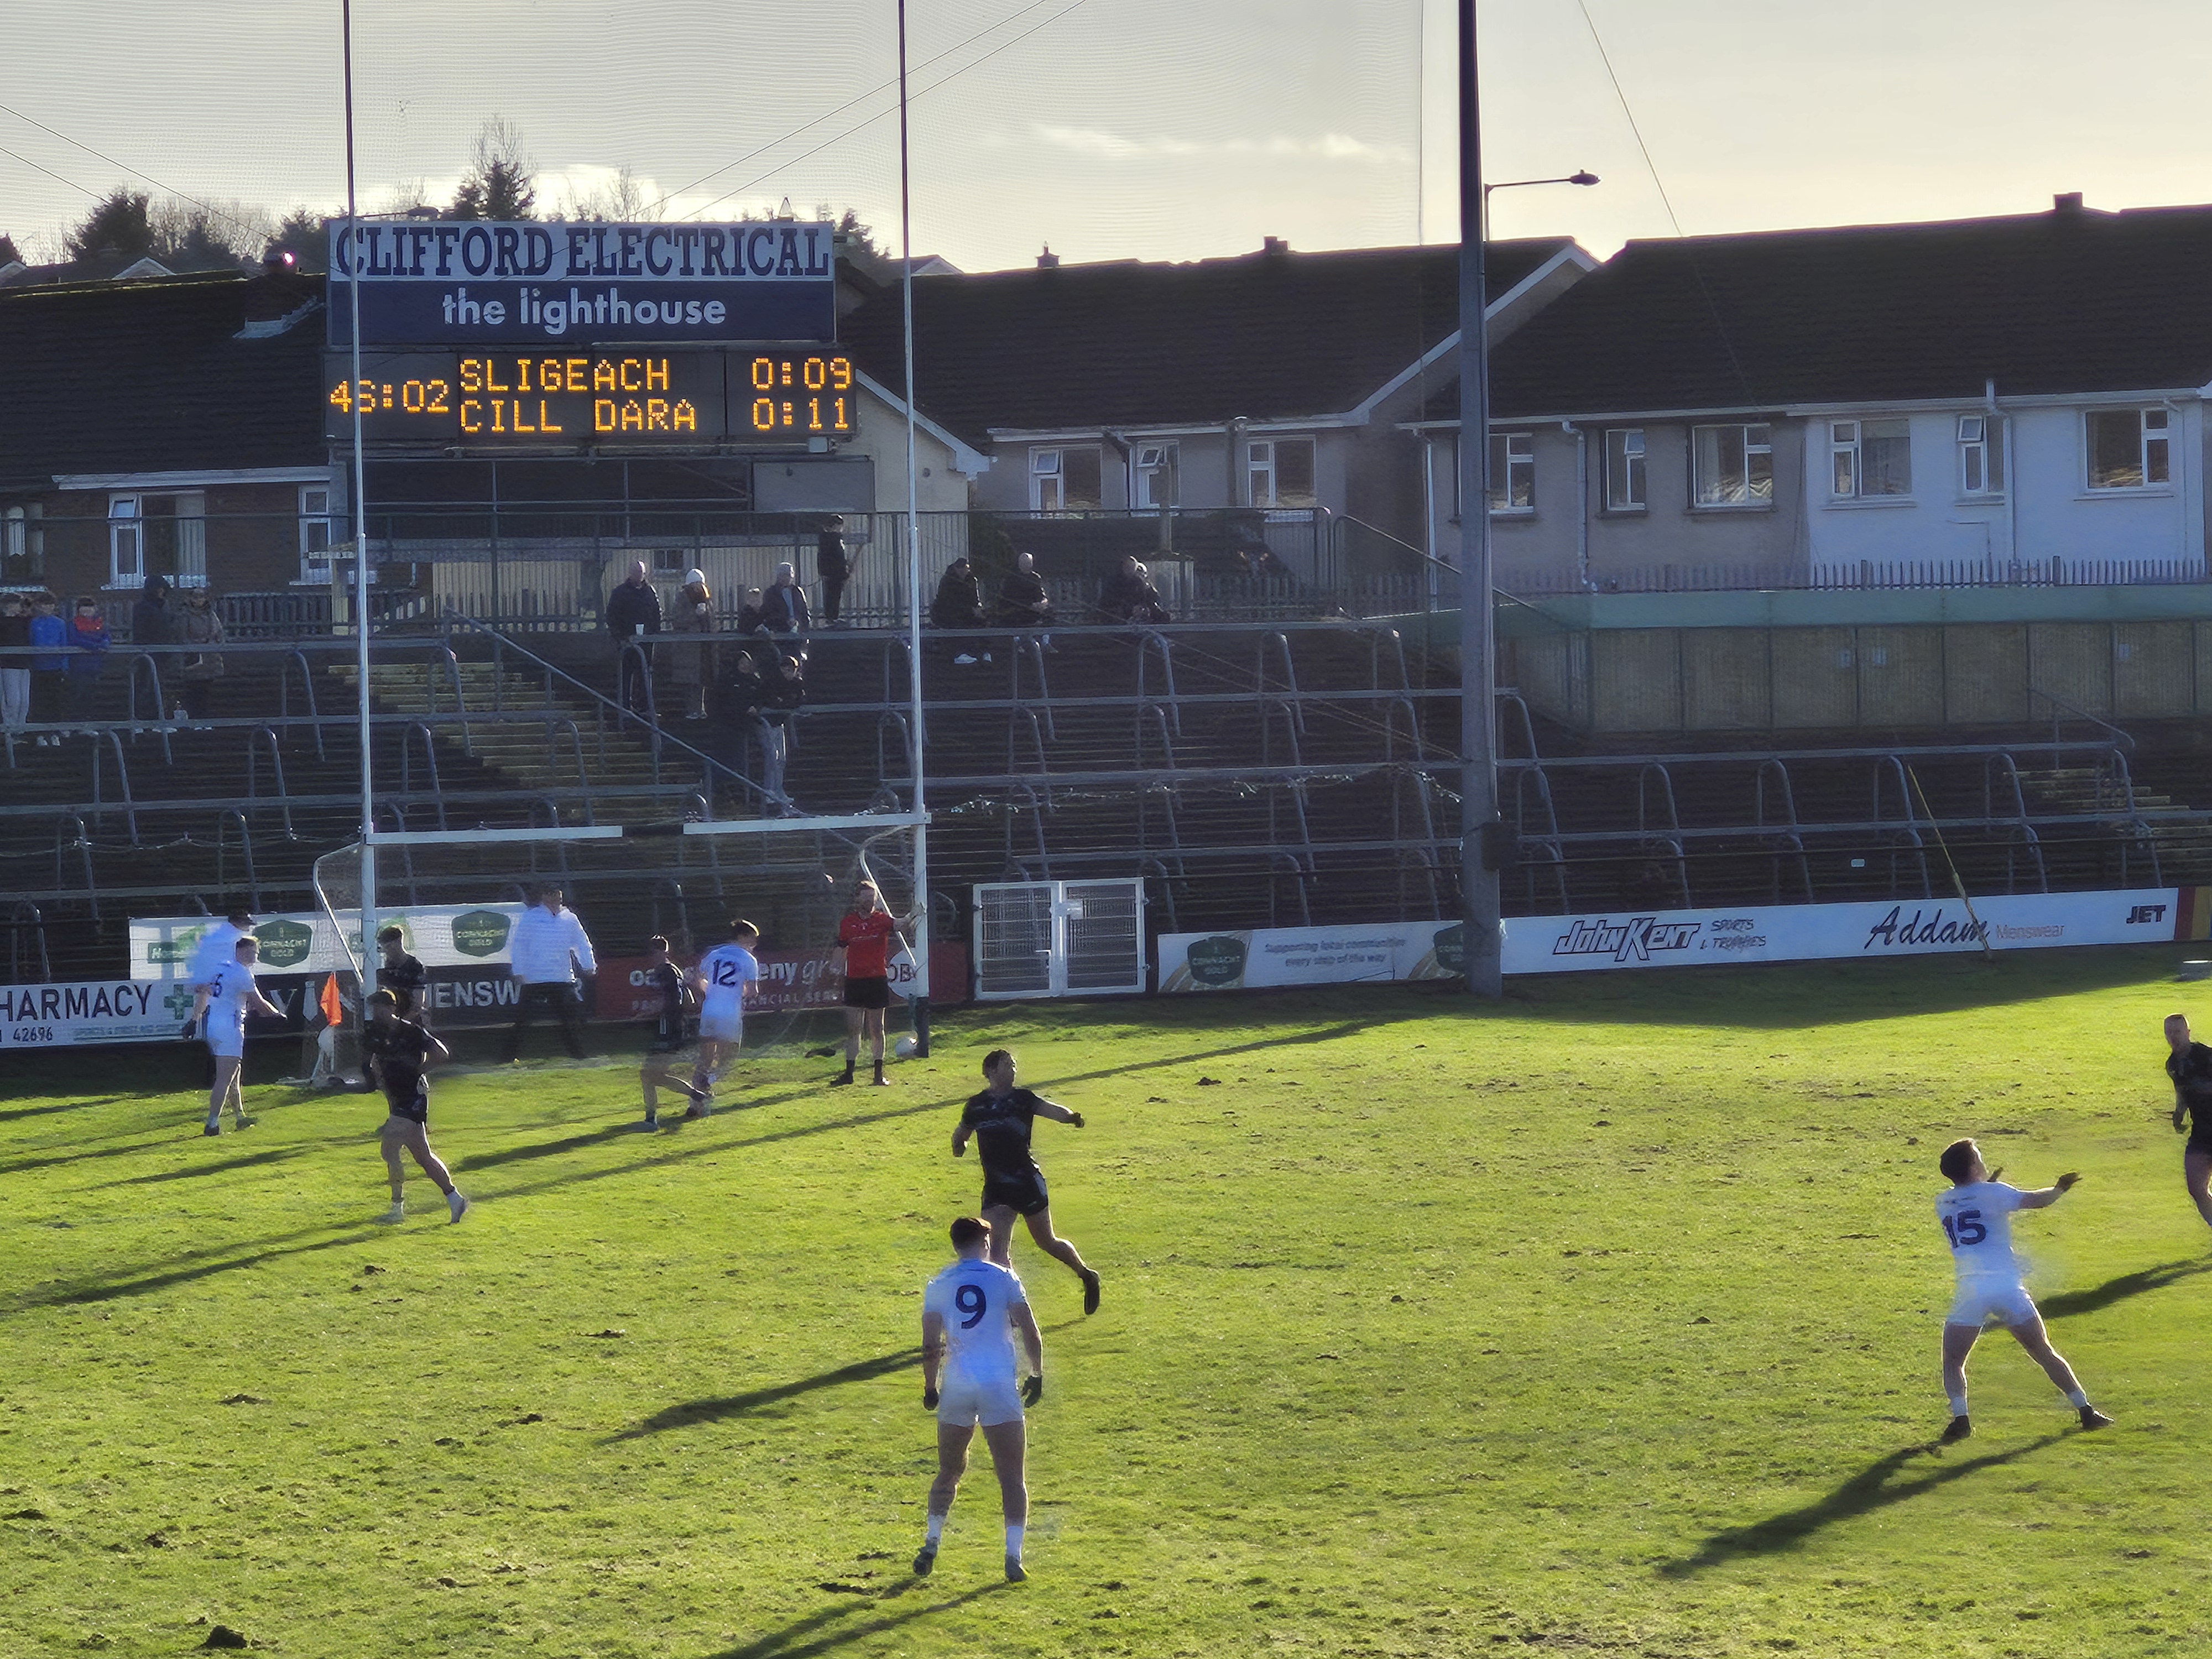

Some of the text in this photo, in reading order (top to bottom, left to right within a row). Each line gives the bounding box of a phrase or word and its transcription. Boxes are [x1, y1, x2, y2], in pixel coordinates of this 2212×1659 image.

[336, 227, 828, 276] CLIFFORD ELECTRICAL
[442, 287, 726, 335] the lighthouse
[460, 357, 851, 392] SLIGEACH 0:09
[461, 398, 849, 433] CILL DARA 0:11
[2126, 905, 2166, 924] JET
[713, 959, 736, 988] 12
[1942, 1209, 1986, 1248] 15
[956, 1284, 987, 1329] 9
